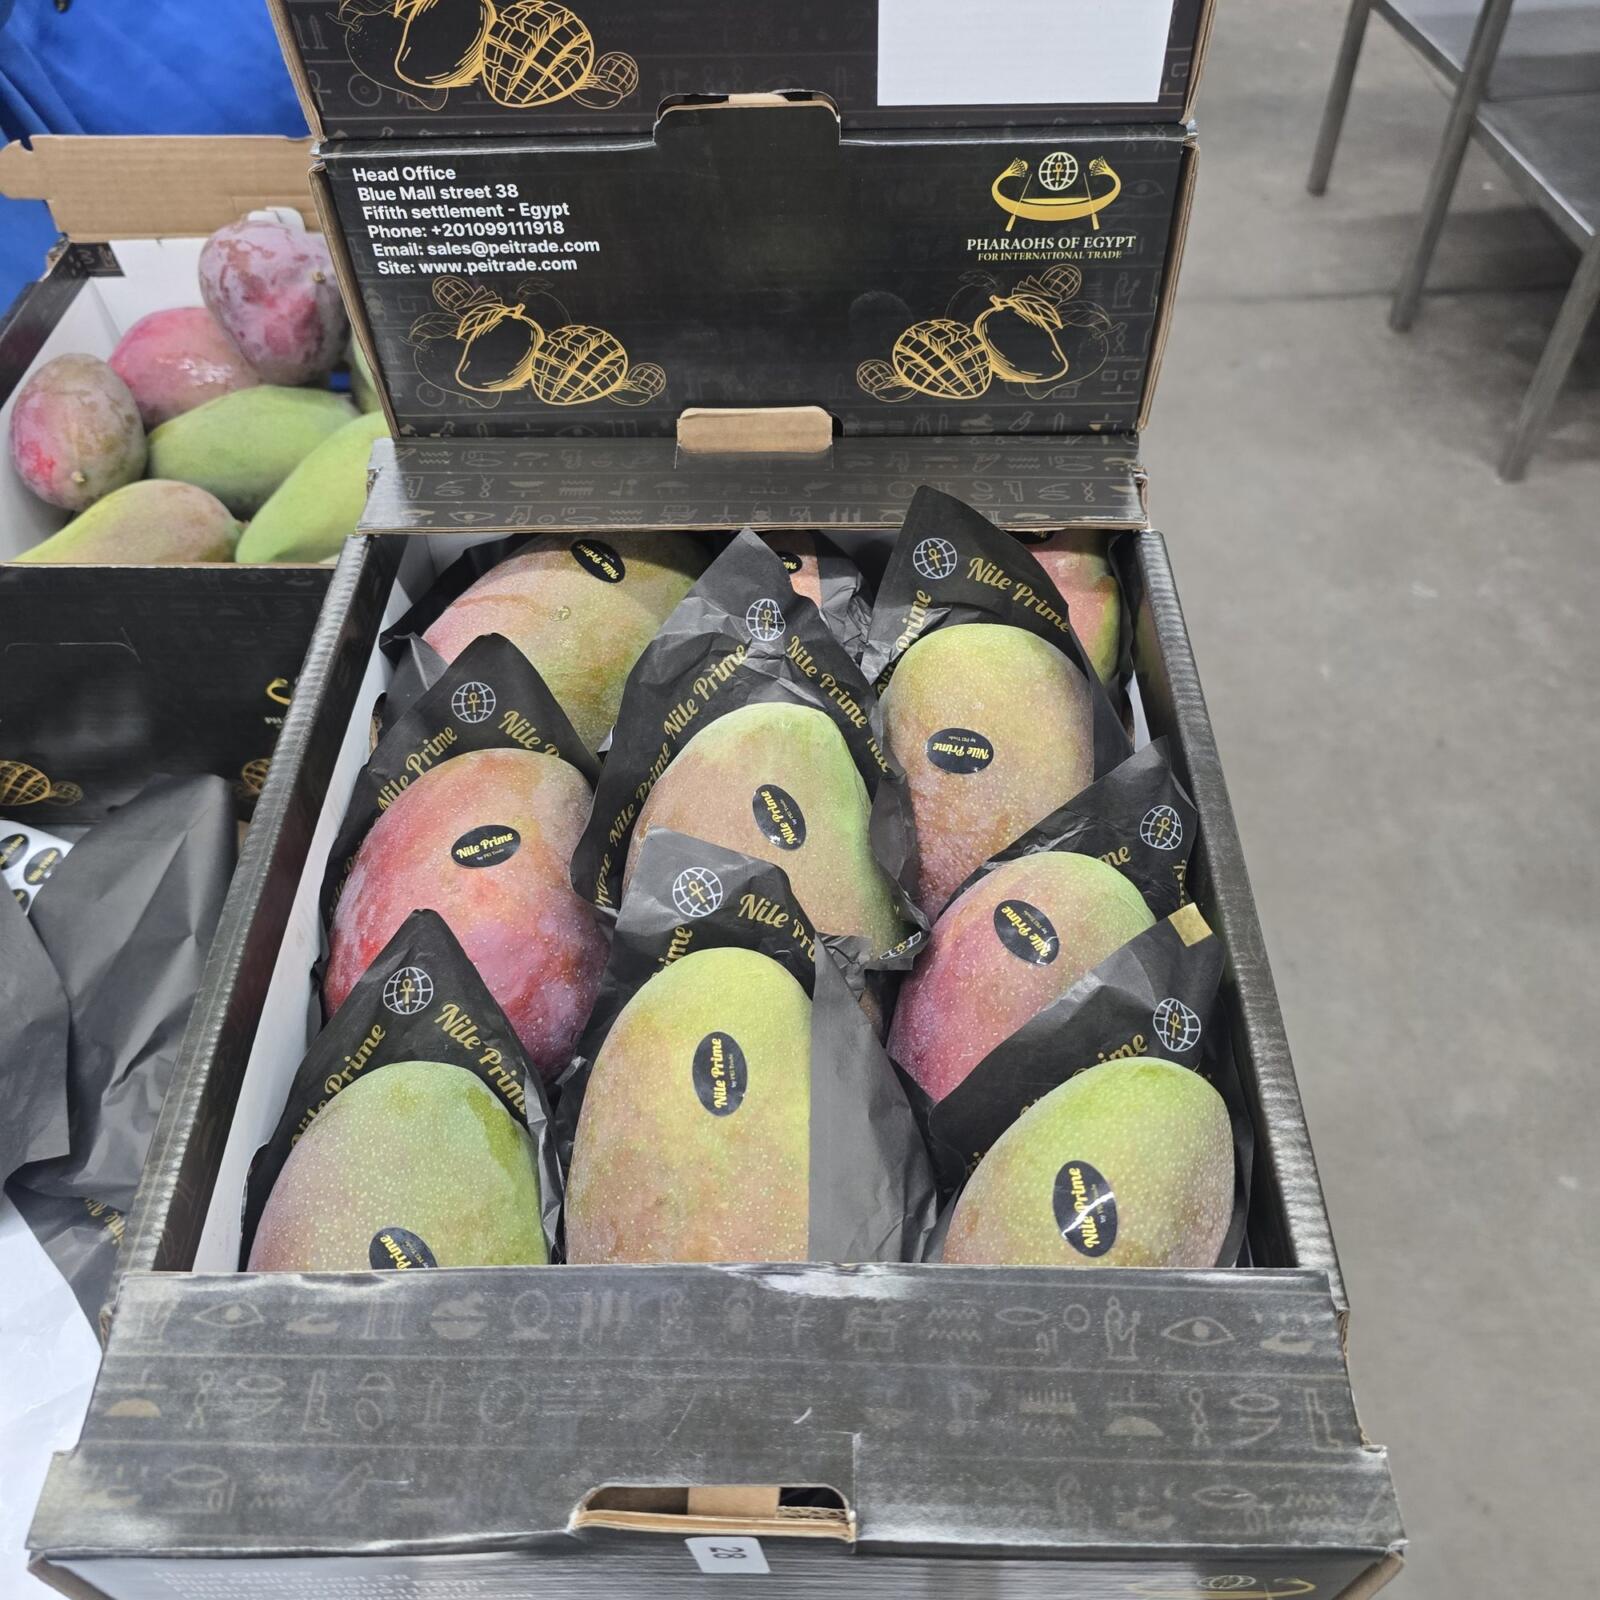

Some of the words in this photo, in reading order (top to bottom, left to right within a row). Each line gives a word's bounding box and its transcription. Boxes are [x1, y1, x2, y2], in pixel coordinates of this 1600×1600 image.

[352, 167, 399, 182] Head
[402, 166, 456, 181] Office
[357, 186, 397, 201] Blue
[399, 186, 436, 200] Mall
[440, 185, 492, 199] street
[495, 184, 519, 198] 38
[362, 205, 408, 220] Fifith
[411, 204, 504, 219] settlement
[519, 202, 571, 219] Egypt
[367, 225, 428, 238] Phone:
[431, 221, 565, 237] +201099111918
[372, 242, 424, 257] Email:
[427, 240, 600, 258] sales@peitrade.com
[967, 238, 1054, 250] PHARAOHS
[1058, 237, 1080, 249] OF
[1084, 236, 1136, 248] EGYPT
[978, 252, 998, 261] FOR
[1001, 251, 1084, 260] INTERNATIONAL
[1087, 251, 1122, 259] TRADE
[377, 261, 416, 274] Site:
[419, 258, 578, 275] www.peitrade.com
[576, 544, 603, 564] Prime
[601, 561, 619, 579] Nile
[967, 557, 1012, 590] Nile
[1012, 583, 1070, 633] Prime
[663, 699, 699, 740] Nile
[693, 644, 749, 700] Prime
[787, 635, 818, 677] Nile
[819, 673, 868, 728] Prime
[498, 710, 542, 749] Nile
[406, 727, 458, 777] Prime
[932, 742, 965, 757] Prime
[966, 747, 990, 760] Nile
[761, 790, 784, 823] Prime
[609, 803, 637, 847] Nile
[780, 822, 798, 845] Nile
[456, 845, 480, 859] Nile
[480, 833, 514, 850] Prime
[738, 893, 789, 928] Nile
[1001, 905, 1032, 937] Prime
[434, 1003, 481, 1050] Nile
[324, 1024, 386, 1094] Prime
[710, 1038, 725, 1078] Prime
[713, 1080, 728, 1108] Nile
[380, 1234, 412, 1271] Prime
[709, 1546, 748, 1559] 28
